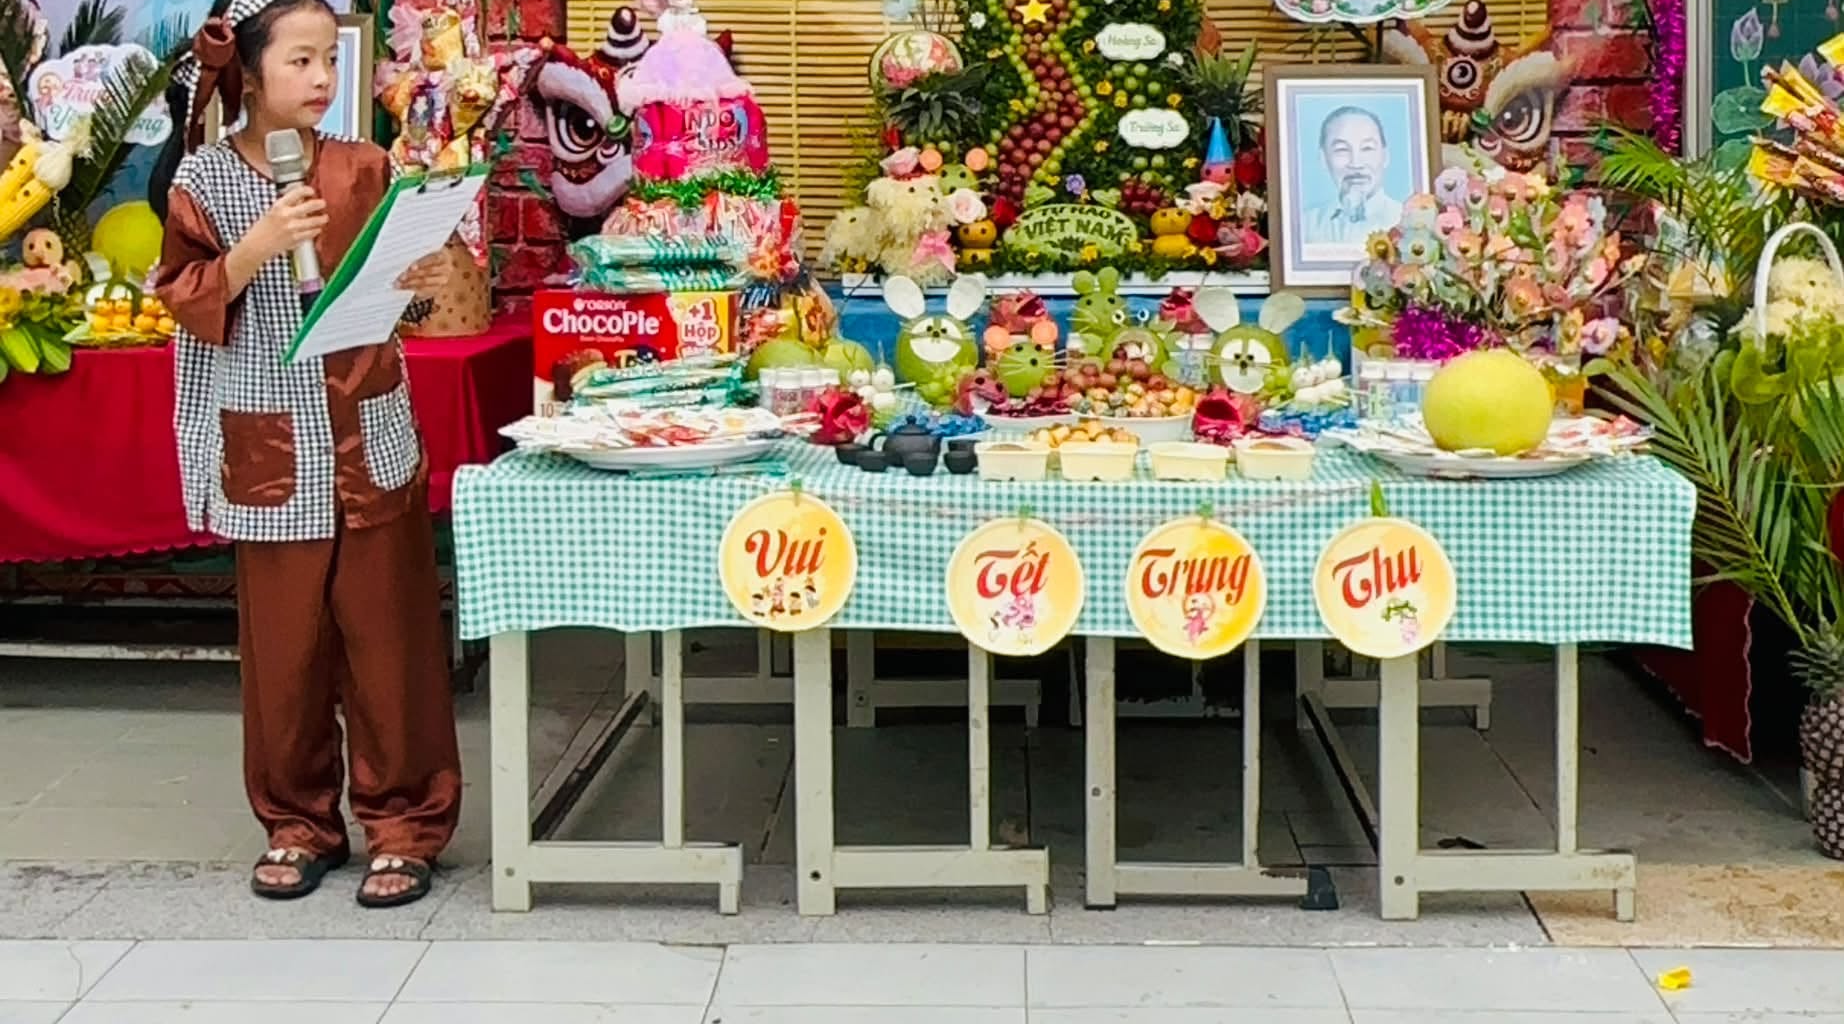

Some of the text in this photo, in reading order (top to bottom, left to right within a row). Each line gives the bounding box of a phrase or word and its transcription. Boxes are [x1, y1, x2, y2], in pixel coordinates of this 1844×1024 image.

[1024, 216, 1125, 246] VIỆT NAM
[542, 307, 660, 335] ChocoPie
[688, 301, 713, 321] +1
[684, 321, 717, 343] Hộp
[744, 527, 827, 577] Vui
[973, 541, 1050, 598] Tết
[1138, 547, 1252, 606] Trung
[1332, 545, 1424, 609] Thu
